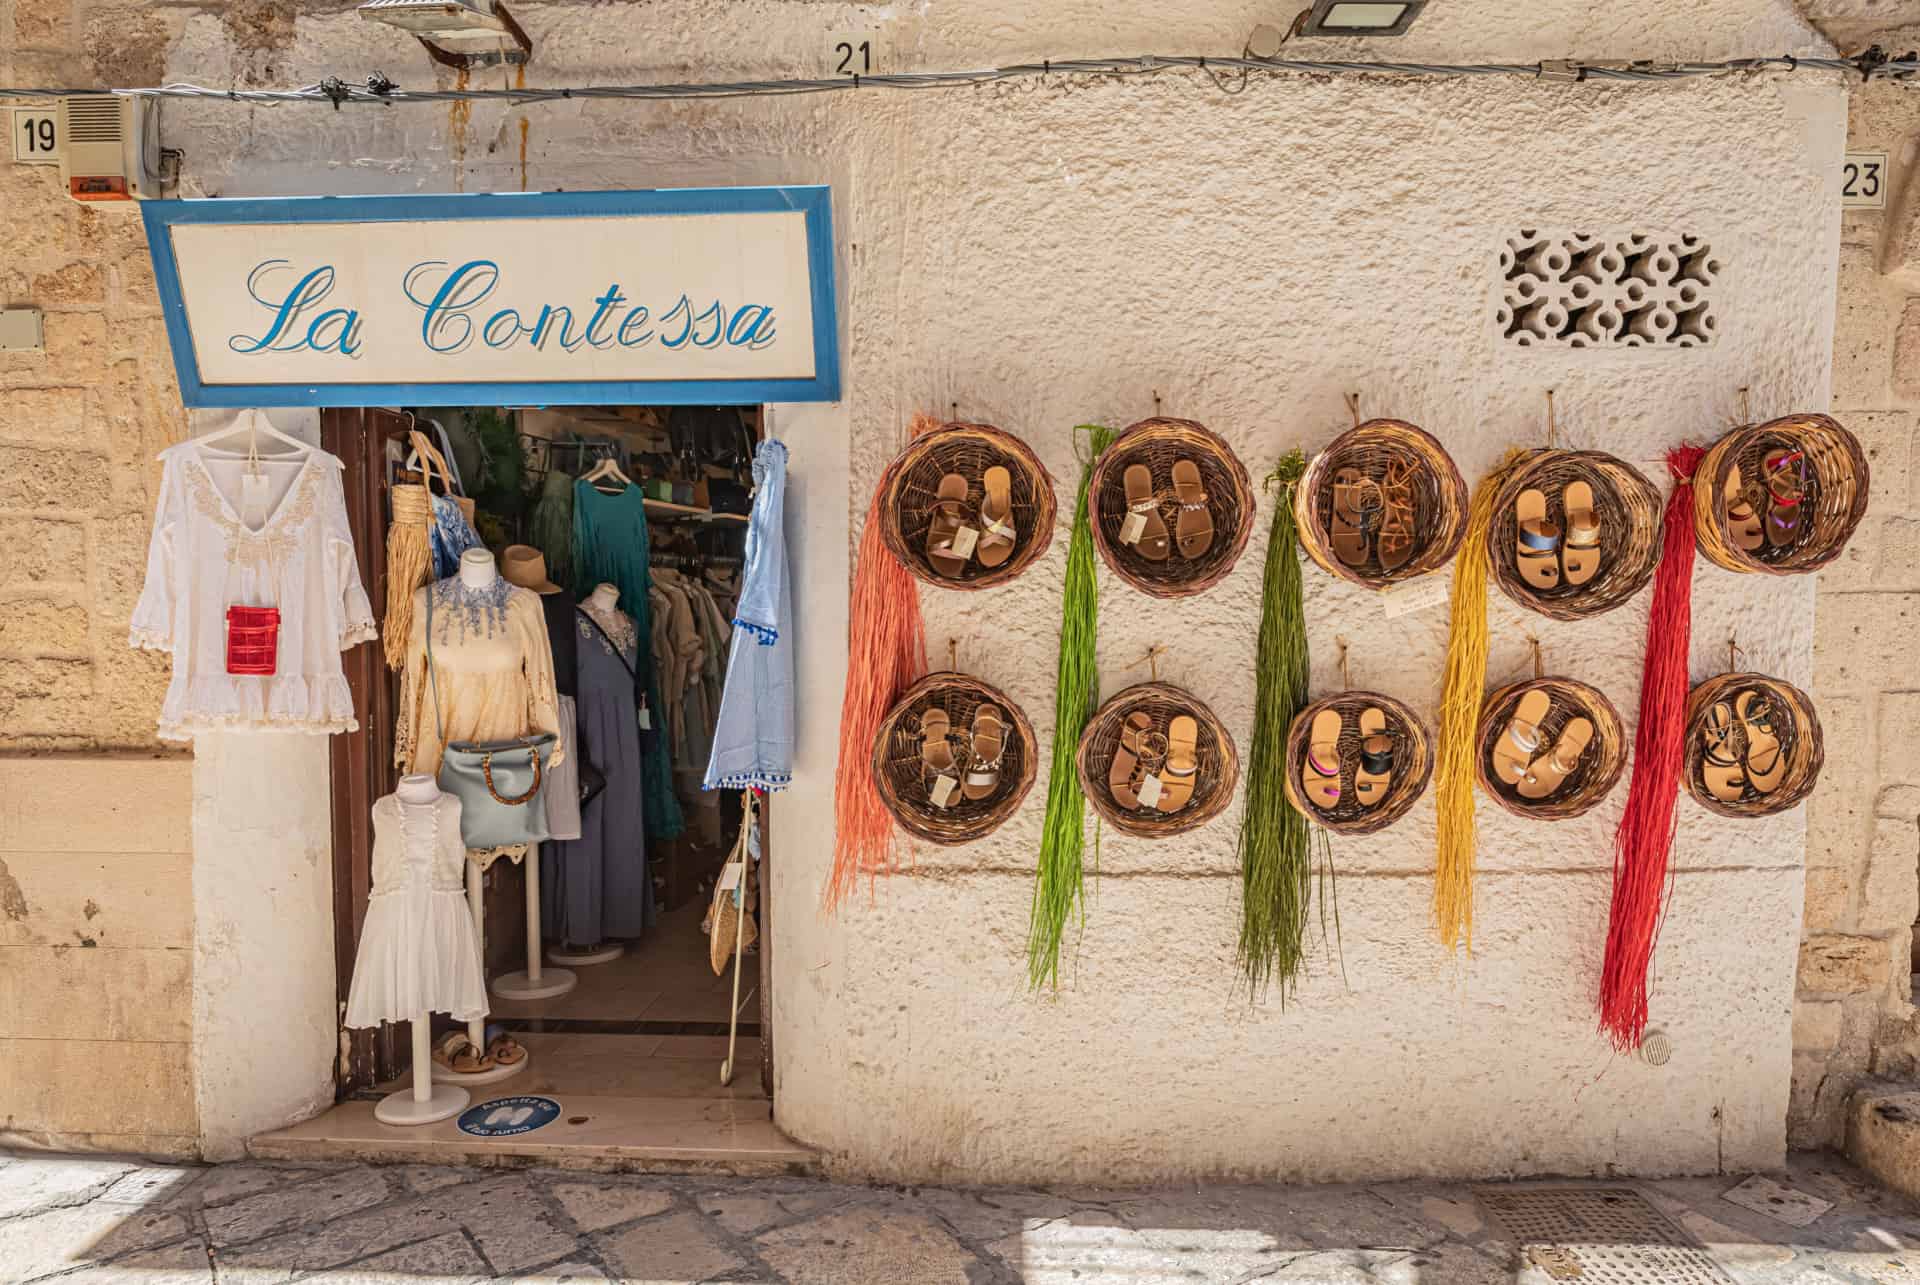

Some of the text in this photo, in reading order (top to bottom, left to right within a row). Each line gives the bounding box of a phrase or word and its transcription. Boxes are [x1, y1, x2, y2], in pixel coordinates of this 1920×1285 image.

[835, 40, 870, 75] 21
[23, 118, 55, 152] 19
[1842, 163, 1880, 197] 23
[229, 258, 778, 357] La Contessa
